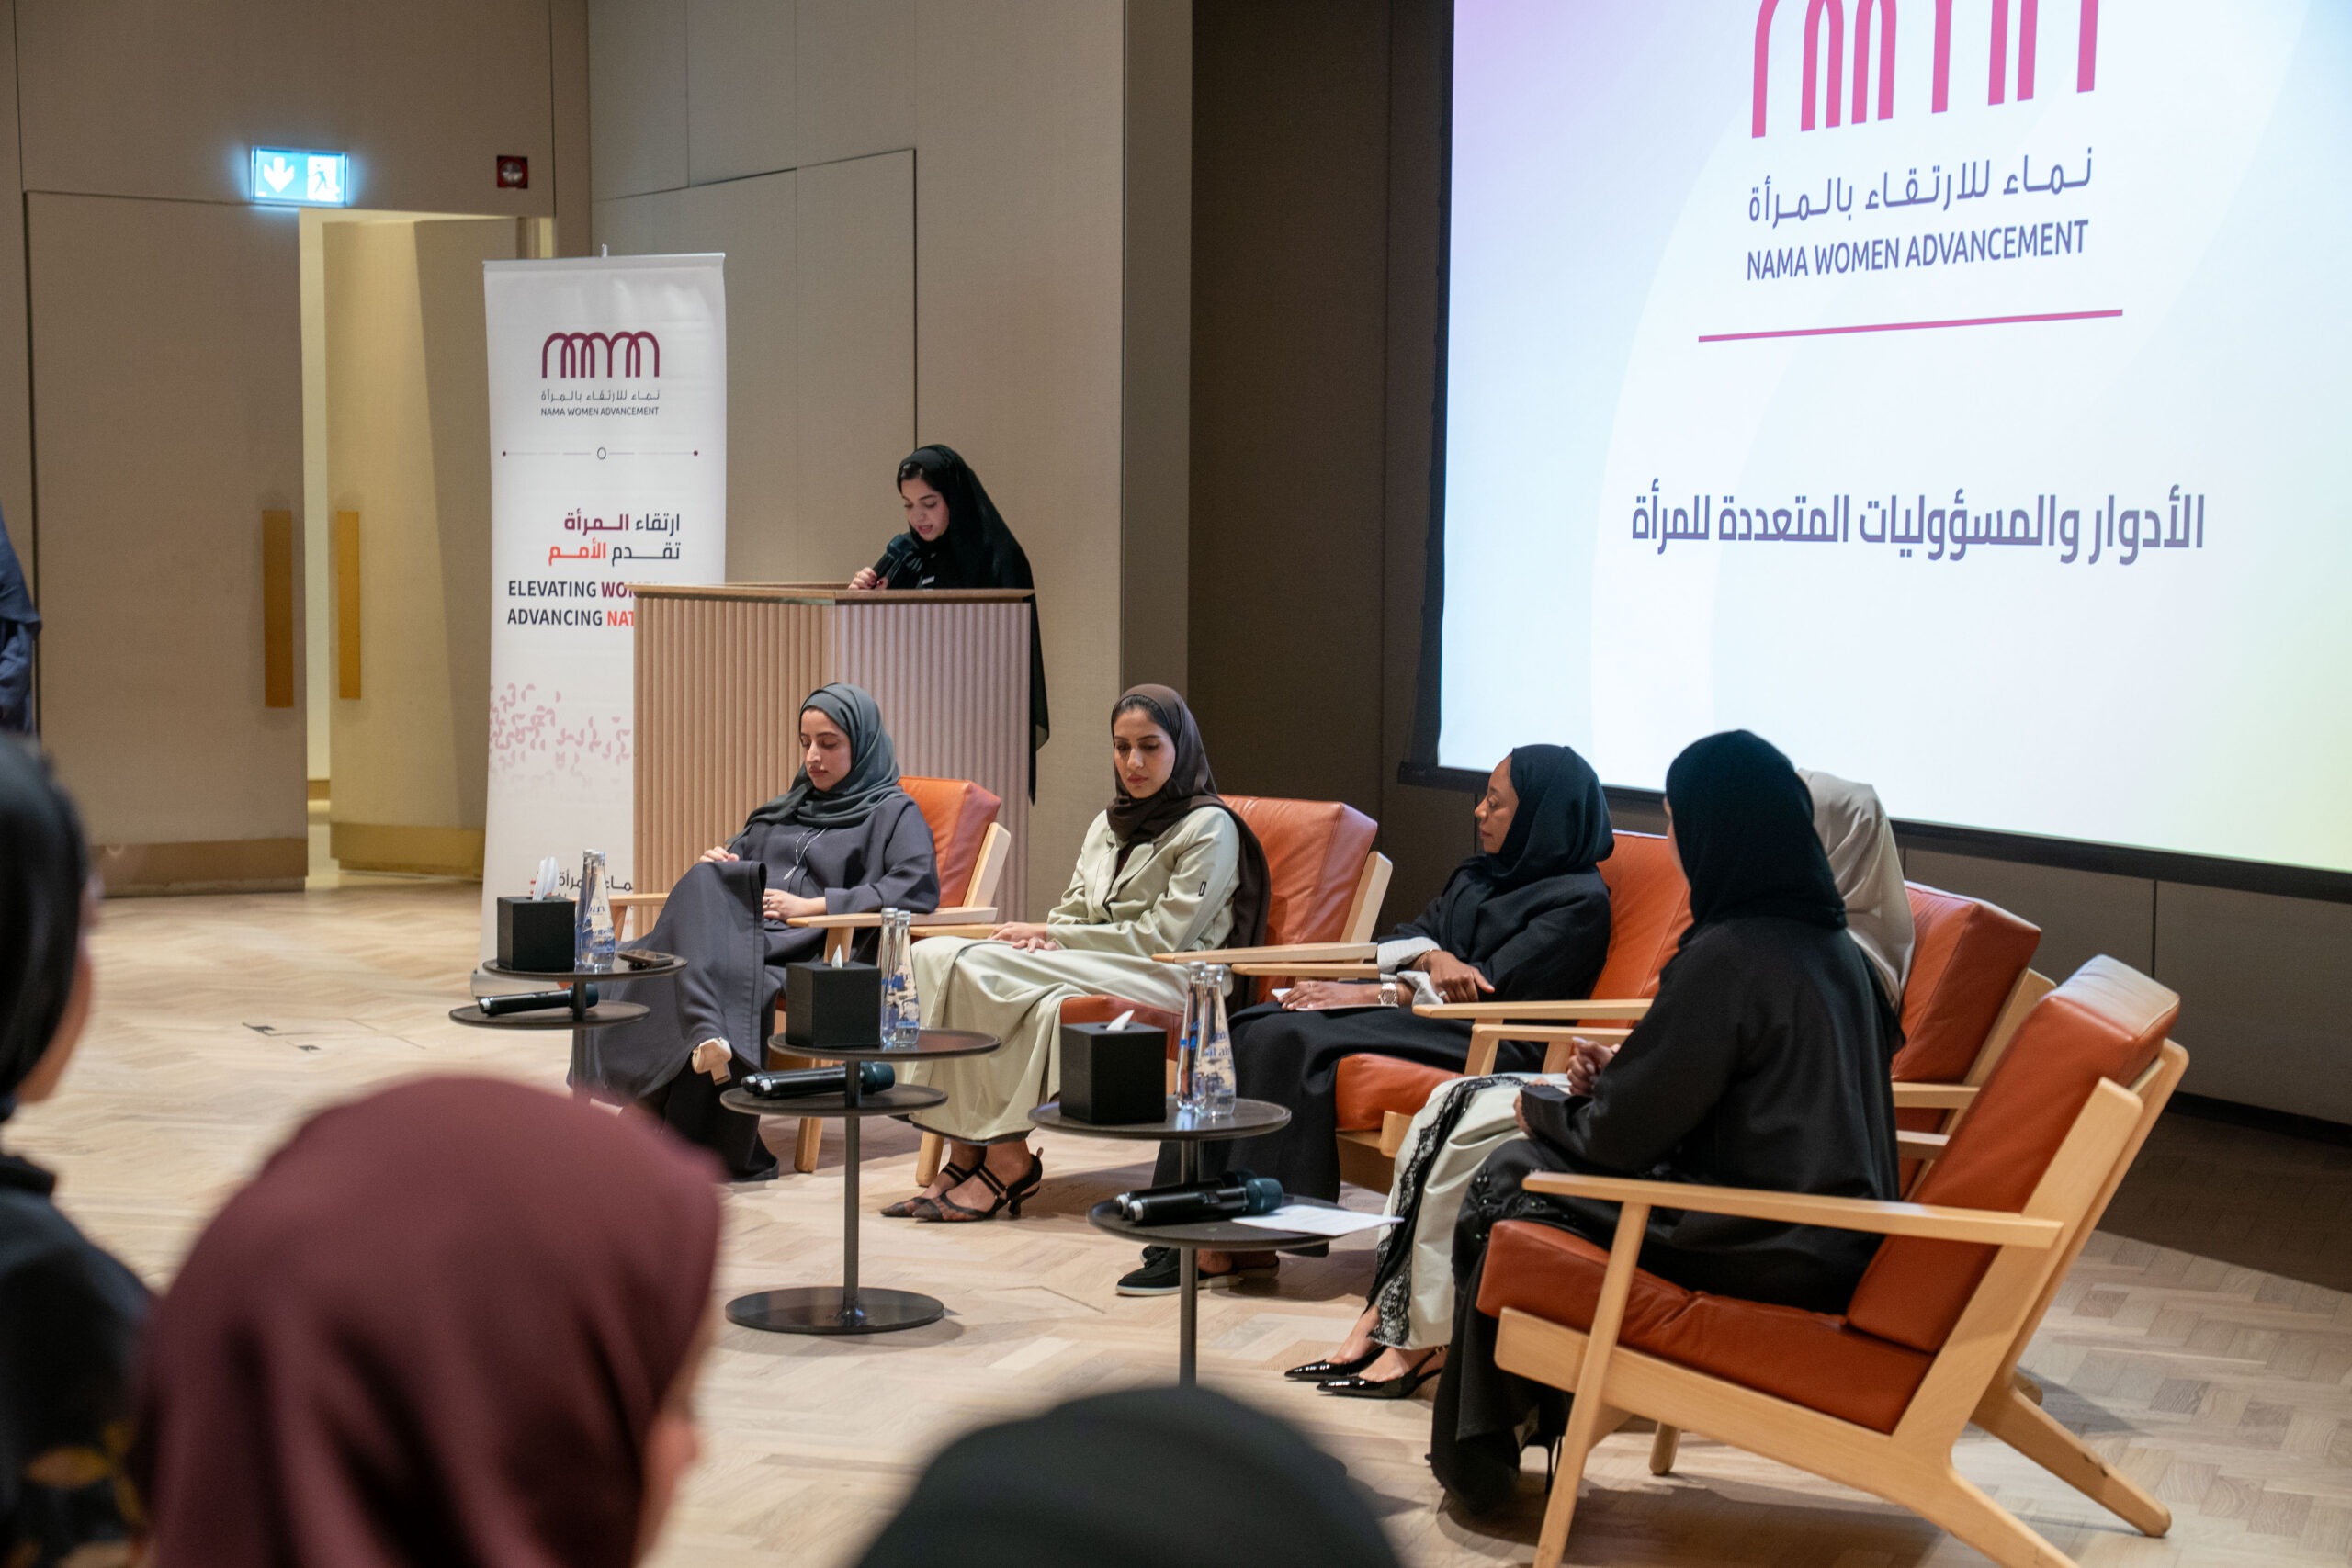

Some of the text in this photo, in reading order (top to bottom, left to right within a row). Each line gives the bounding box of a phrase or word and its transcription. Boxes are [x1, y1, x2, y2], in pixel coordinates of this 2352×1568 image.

[1749, 147, 2092, 229] نماء للارتقاء بالمرأة
[1747, 219, 2089, 281] NAMA WOMEN ADVANCEMENT
[631, 389, 660, 401] نماء
[540, 406, 660, 416] NAMA WOMEN ADVANCEMENT
[564, 508, 680, 536] ارتقاء المرأة
[1632, 478, 2205, 565] الأدوار والمسؤوليات المتعددة للمرأة
[548, 537, 681, 567] تقدم الأمم
[508, 581, 597, 598] ELEVATING
[507, 609, 634, 626] ADVANCING NAT
